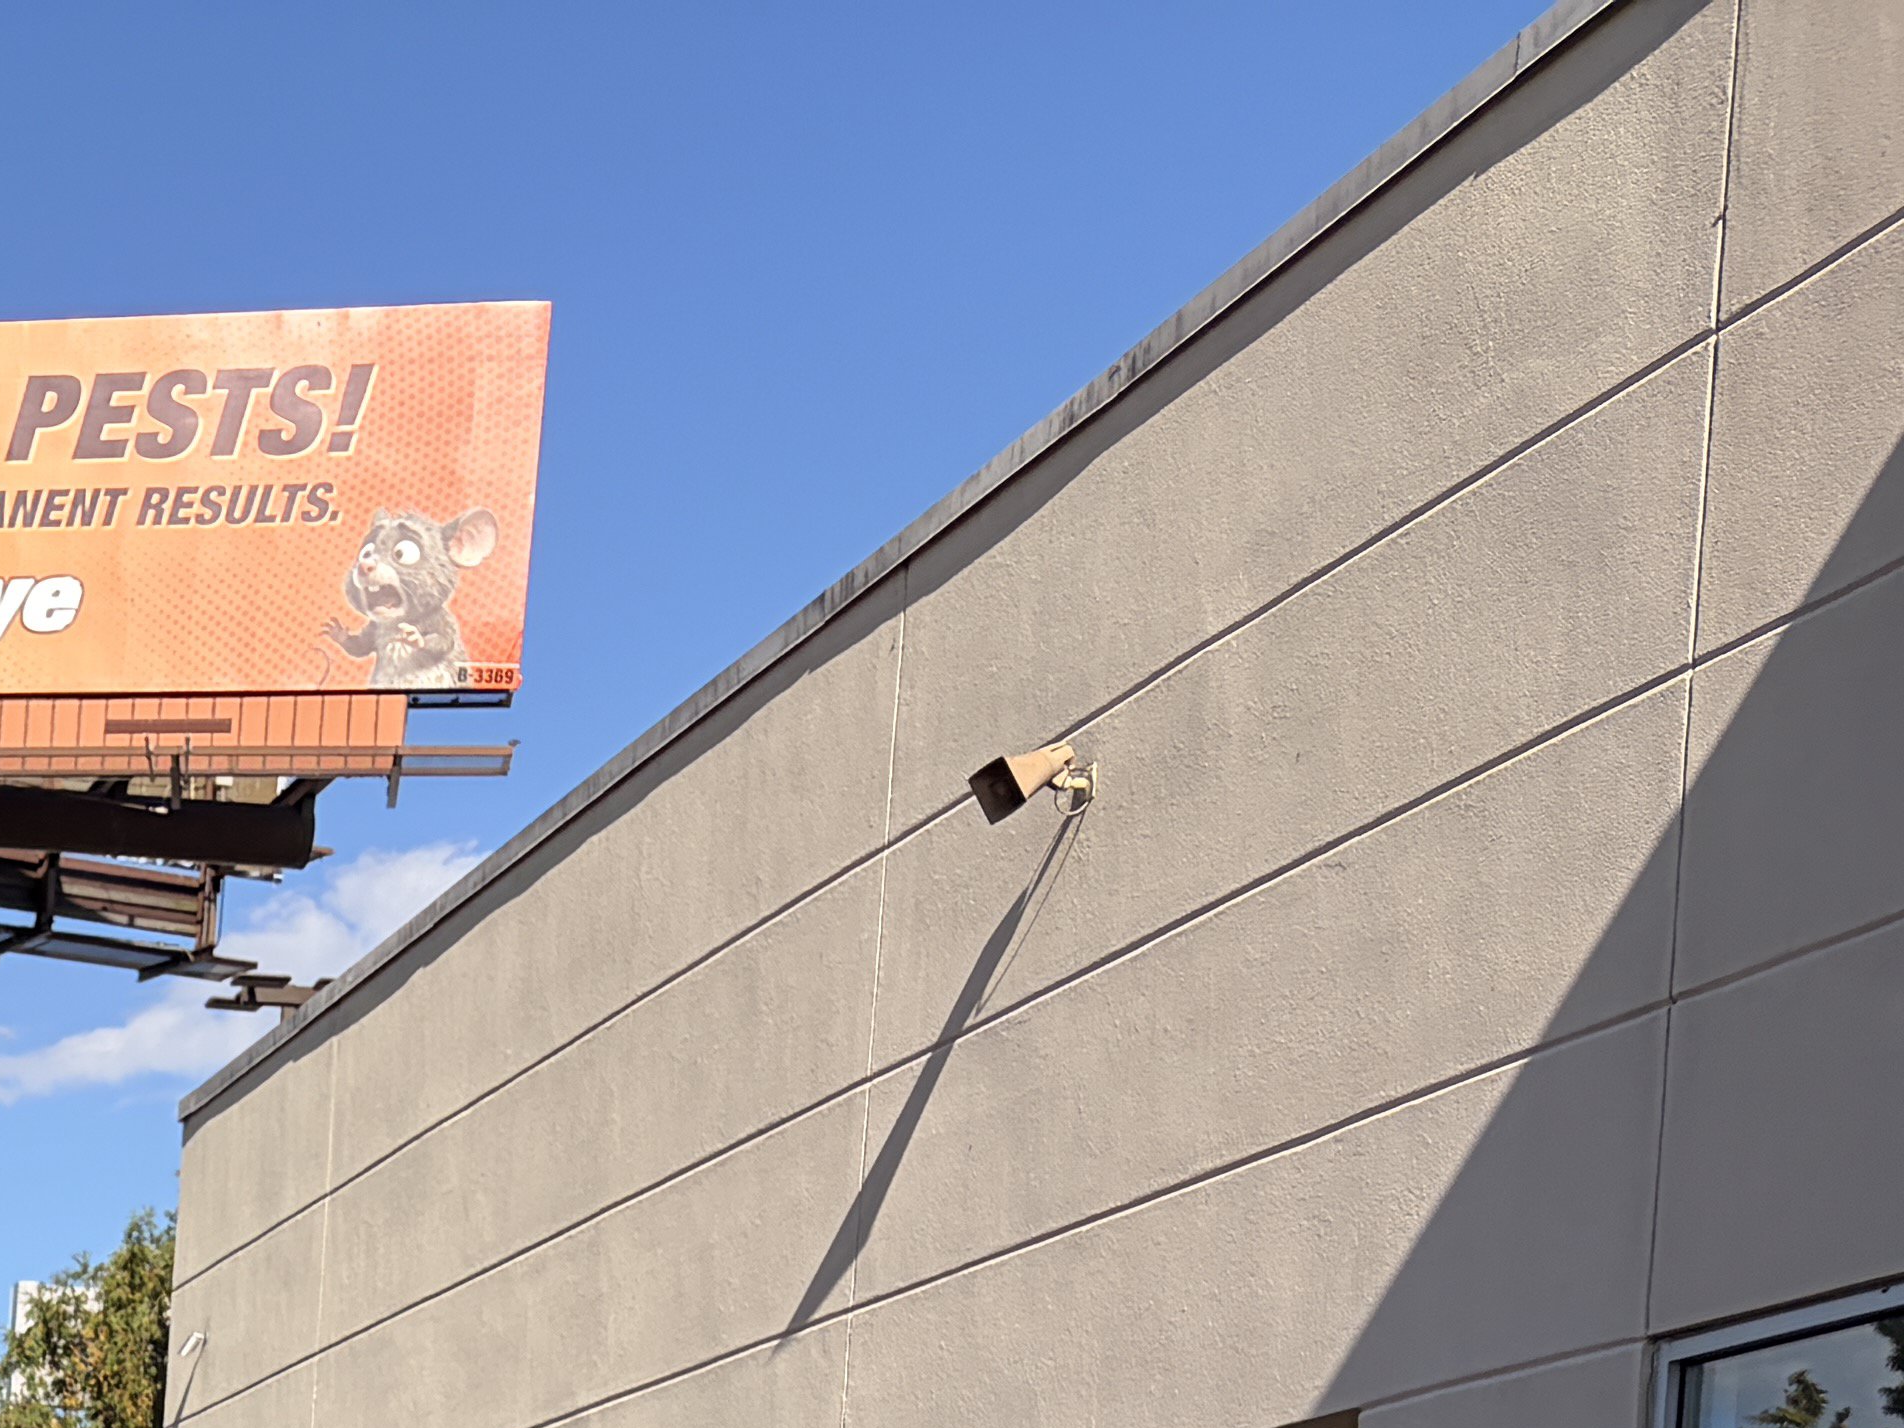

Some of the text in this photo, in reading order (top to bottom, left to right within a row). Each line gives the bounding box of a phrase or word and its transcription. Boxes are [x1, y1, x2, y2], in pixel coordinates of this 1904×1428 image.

[5, 363, 376, 461] PESTS!
[136, 482, 341, 527] RESULTS.
[457, 666, 515, 685] B-3369
